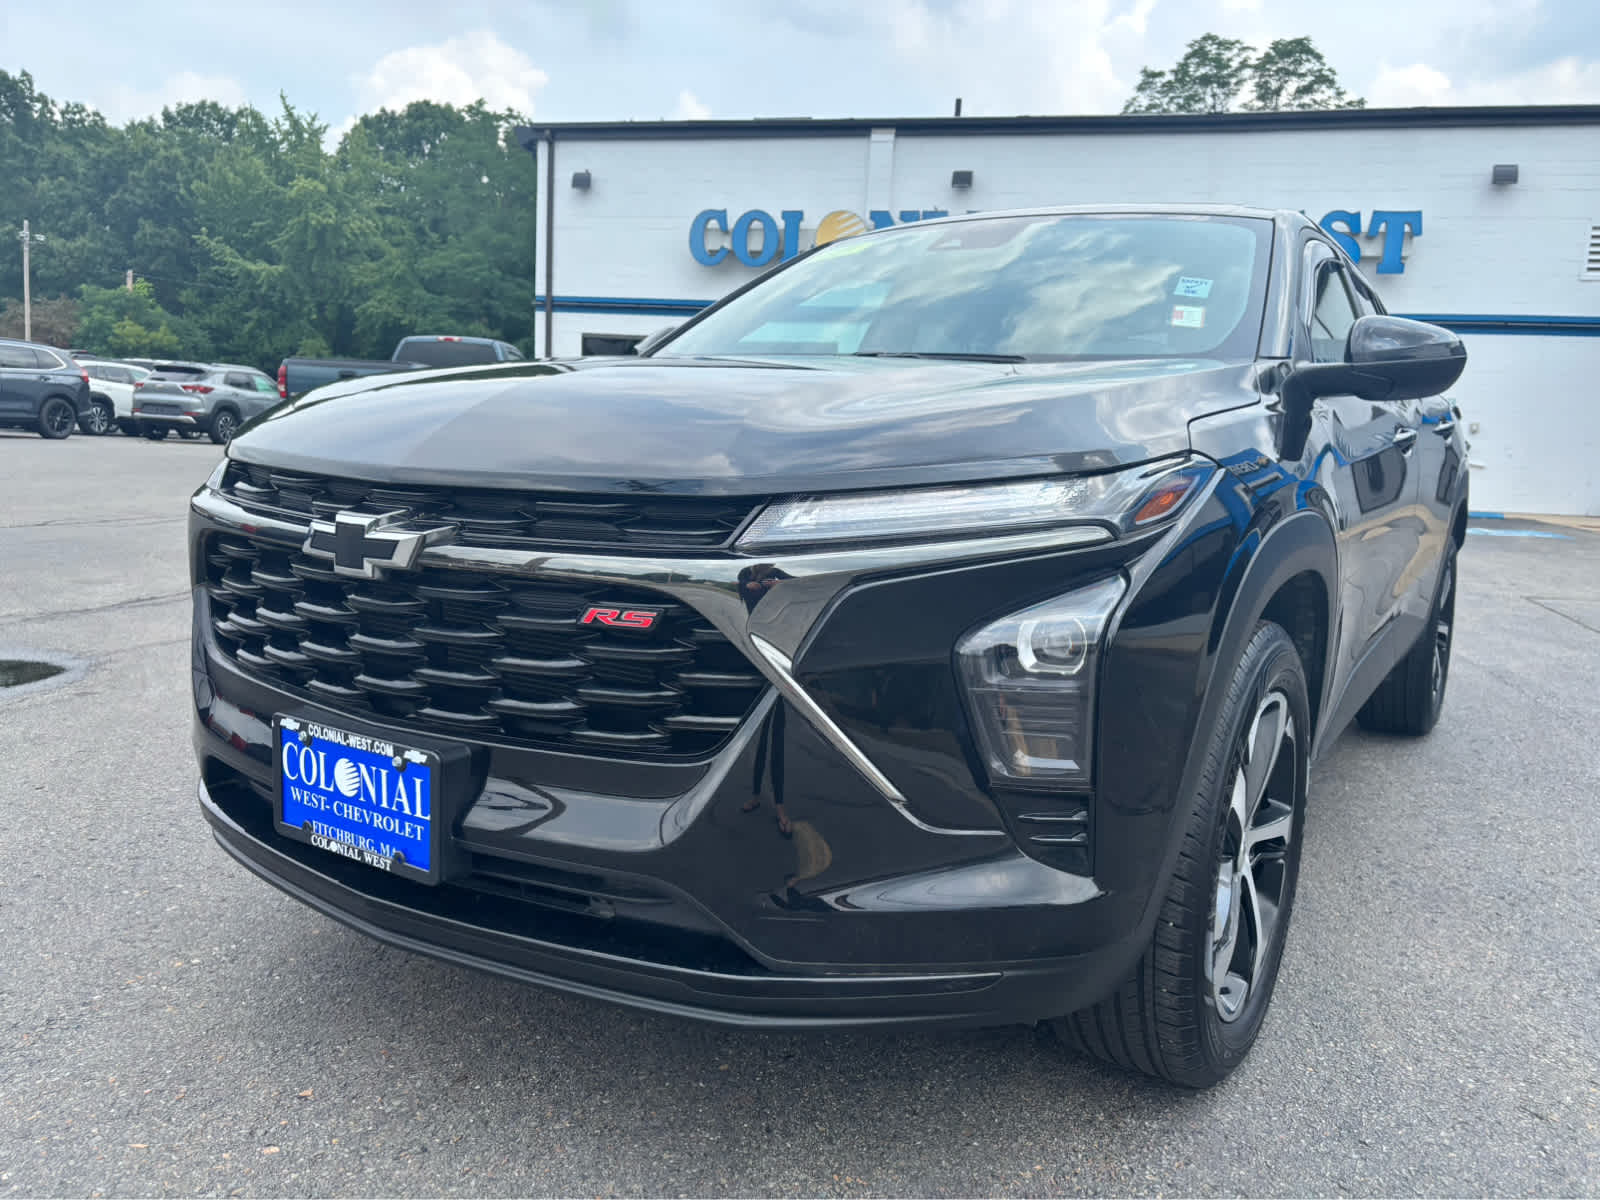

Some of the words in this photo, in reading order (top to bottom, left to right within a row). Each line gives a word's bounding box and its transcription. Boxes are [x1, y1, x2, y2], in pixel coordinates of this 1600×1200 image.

[1317, 209, 1423, 275] ST
[583, 607, 657, 628] RS
[308, 724, 394, 758] COLONIAL-WEST.COM
[282, 741, 432, 821] COLONIAL
[333, 800, 425, 841] CHEVROLET
[311, 834, 361, 861] COLONIAL
[363, 852, 393, 872] WEST
